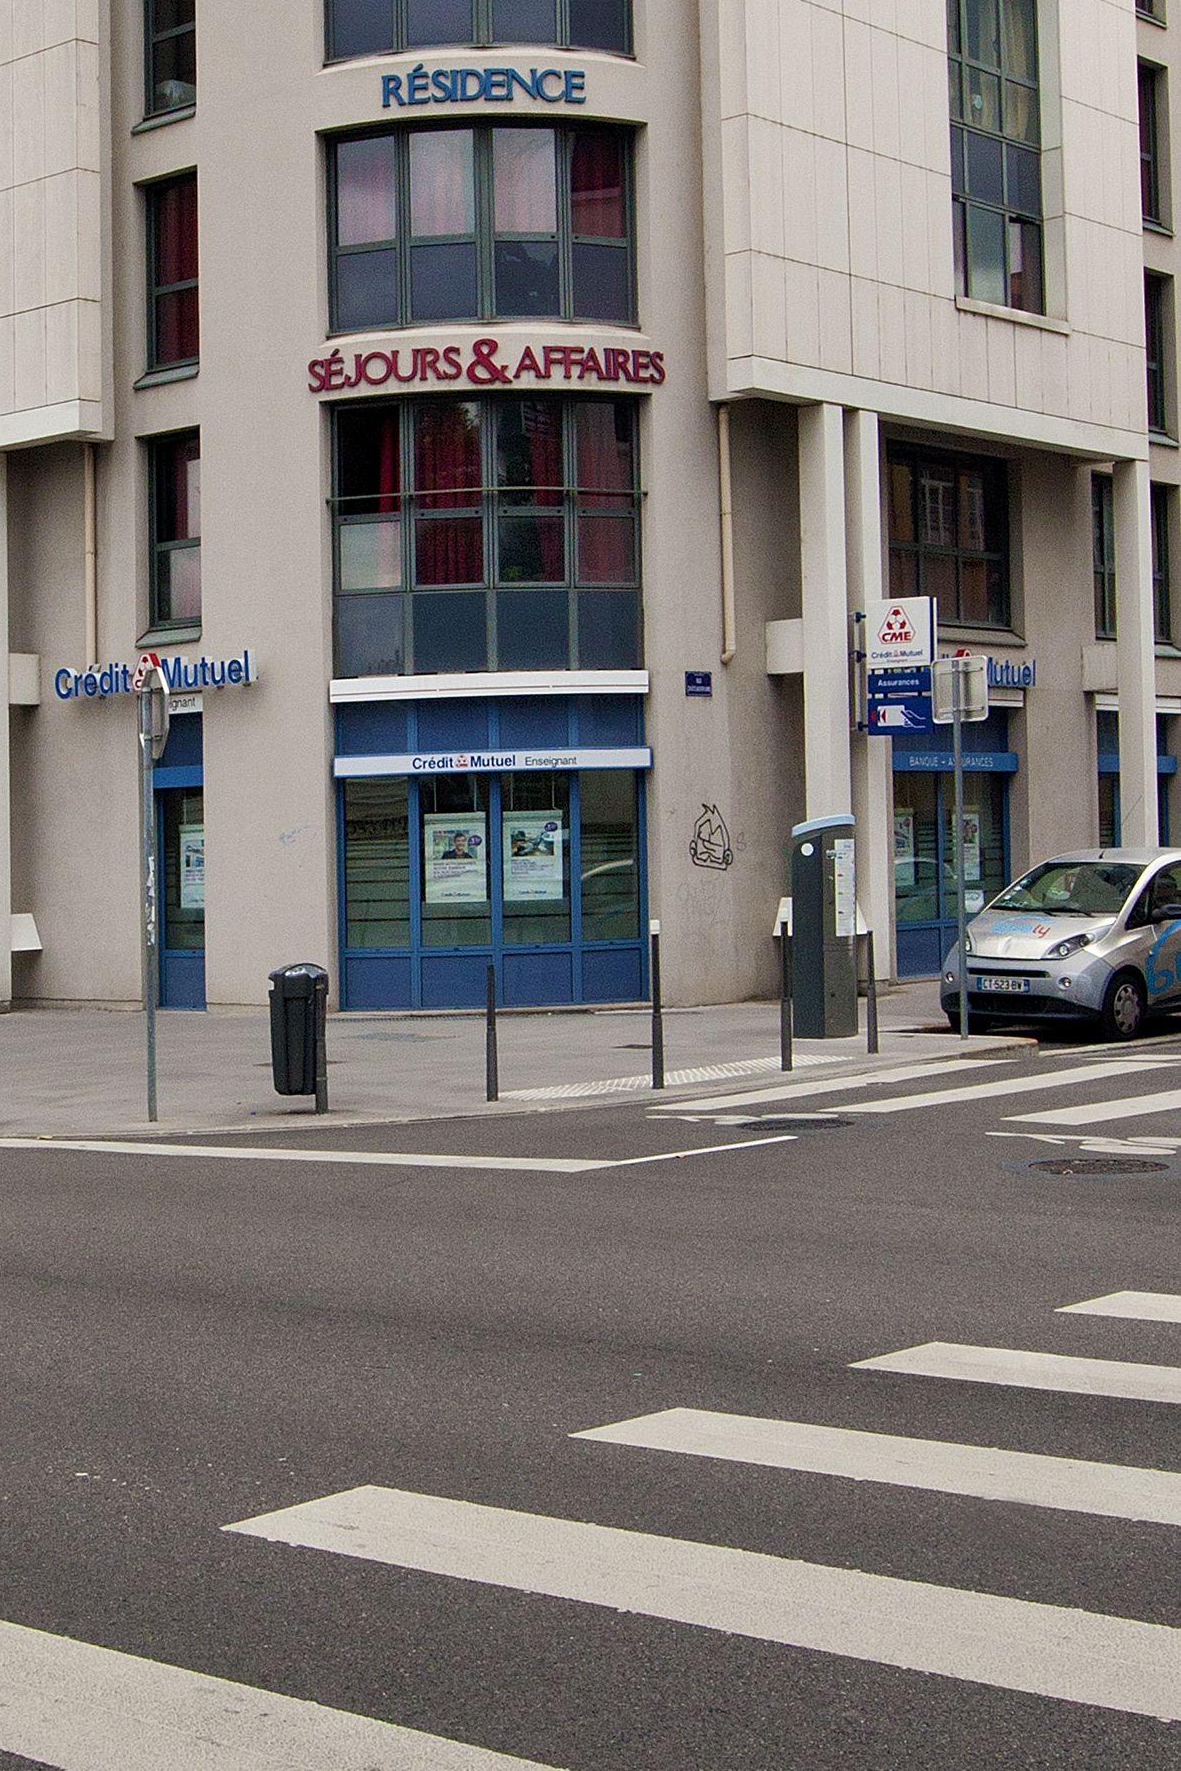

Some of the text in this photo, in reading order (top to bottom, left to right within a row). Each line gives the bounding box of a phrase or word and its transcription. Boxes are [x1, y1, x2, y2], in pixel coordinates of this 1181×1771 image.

[381, 63, 587, 107] RÉSIDENCE
[308, 338, 666, 393] SÉJOURS & AFFAIRES
[882, 631, 912, 642] CME
[900, 649, 923, 658] Mutuel
[54, 650, 250, 700] Crédit Mutuel
[878, 679, 920, 687] Assurances
[412, 755, 577, 769] Crédit Mutuel Enseignant
[910, 756, 938, 767] BANQUE
